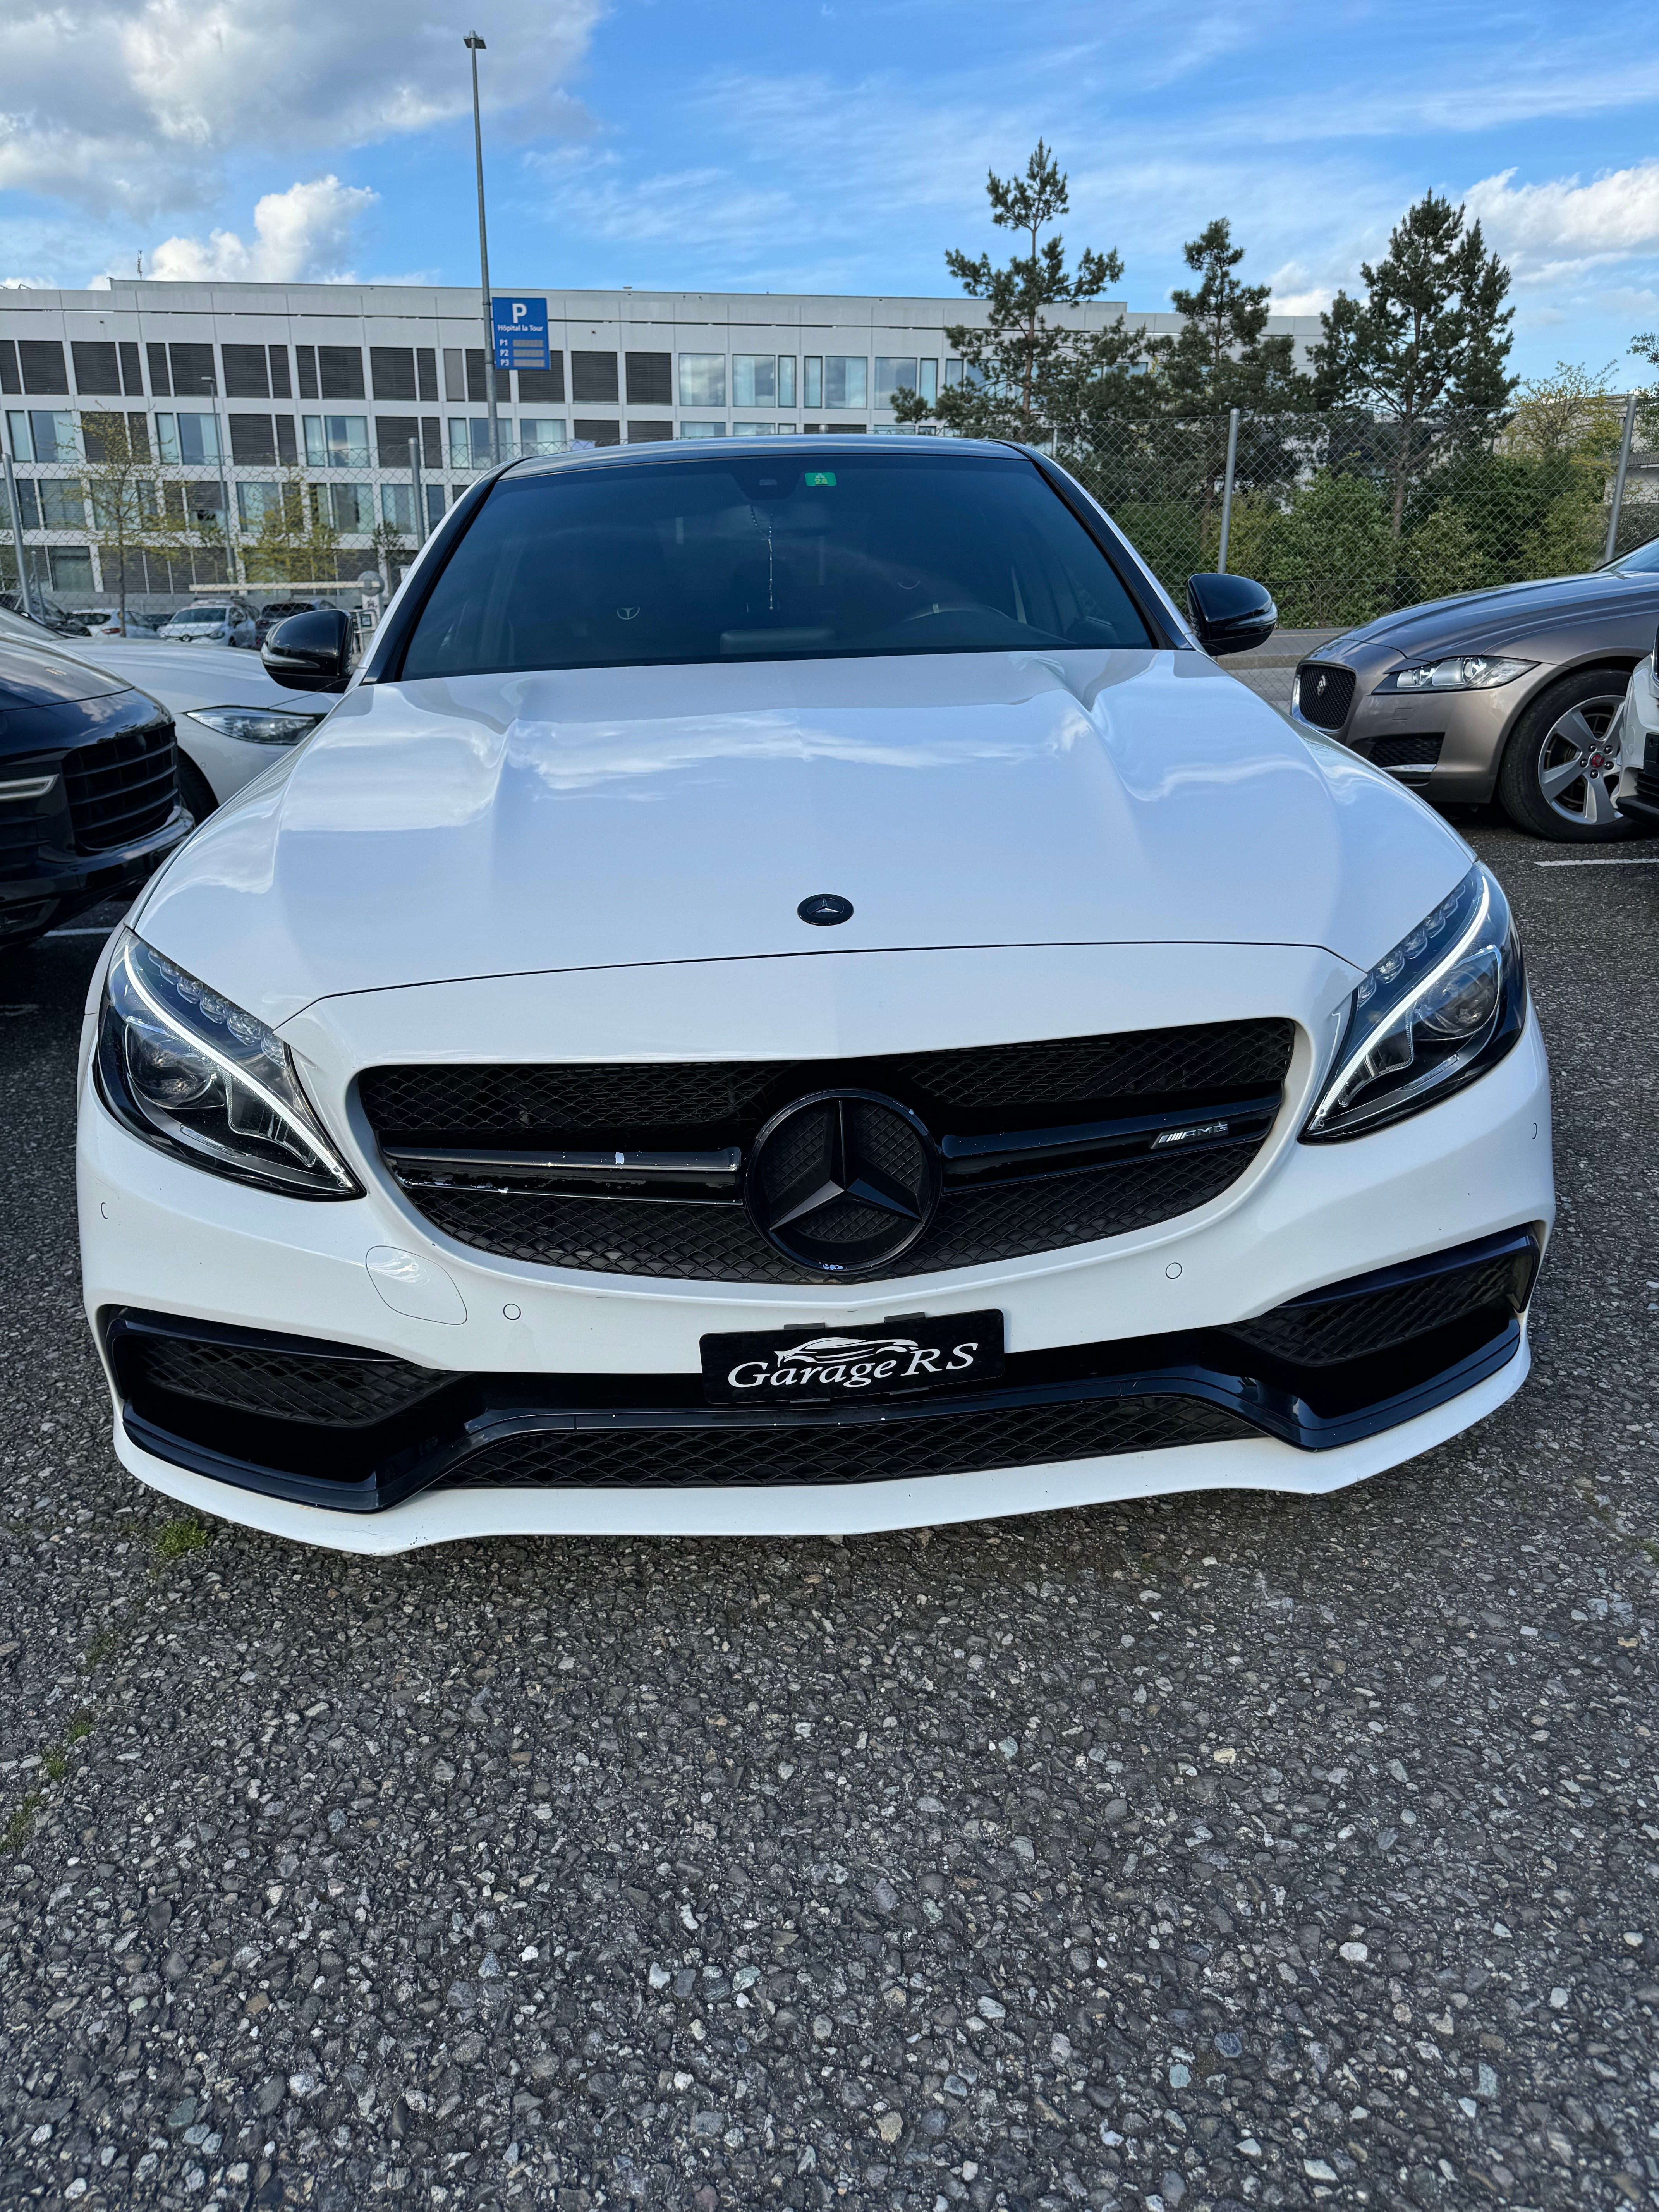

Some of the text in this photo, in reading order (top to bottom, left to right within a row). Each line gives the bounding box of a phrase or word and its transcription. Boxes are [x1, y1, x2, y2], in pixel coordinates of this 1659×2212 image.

[512, 303, 527, 323] P
[728, 1343, 979, 1388] Garage RS
